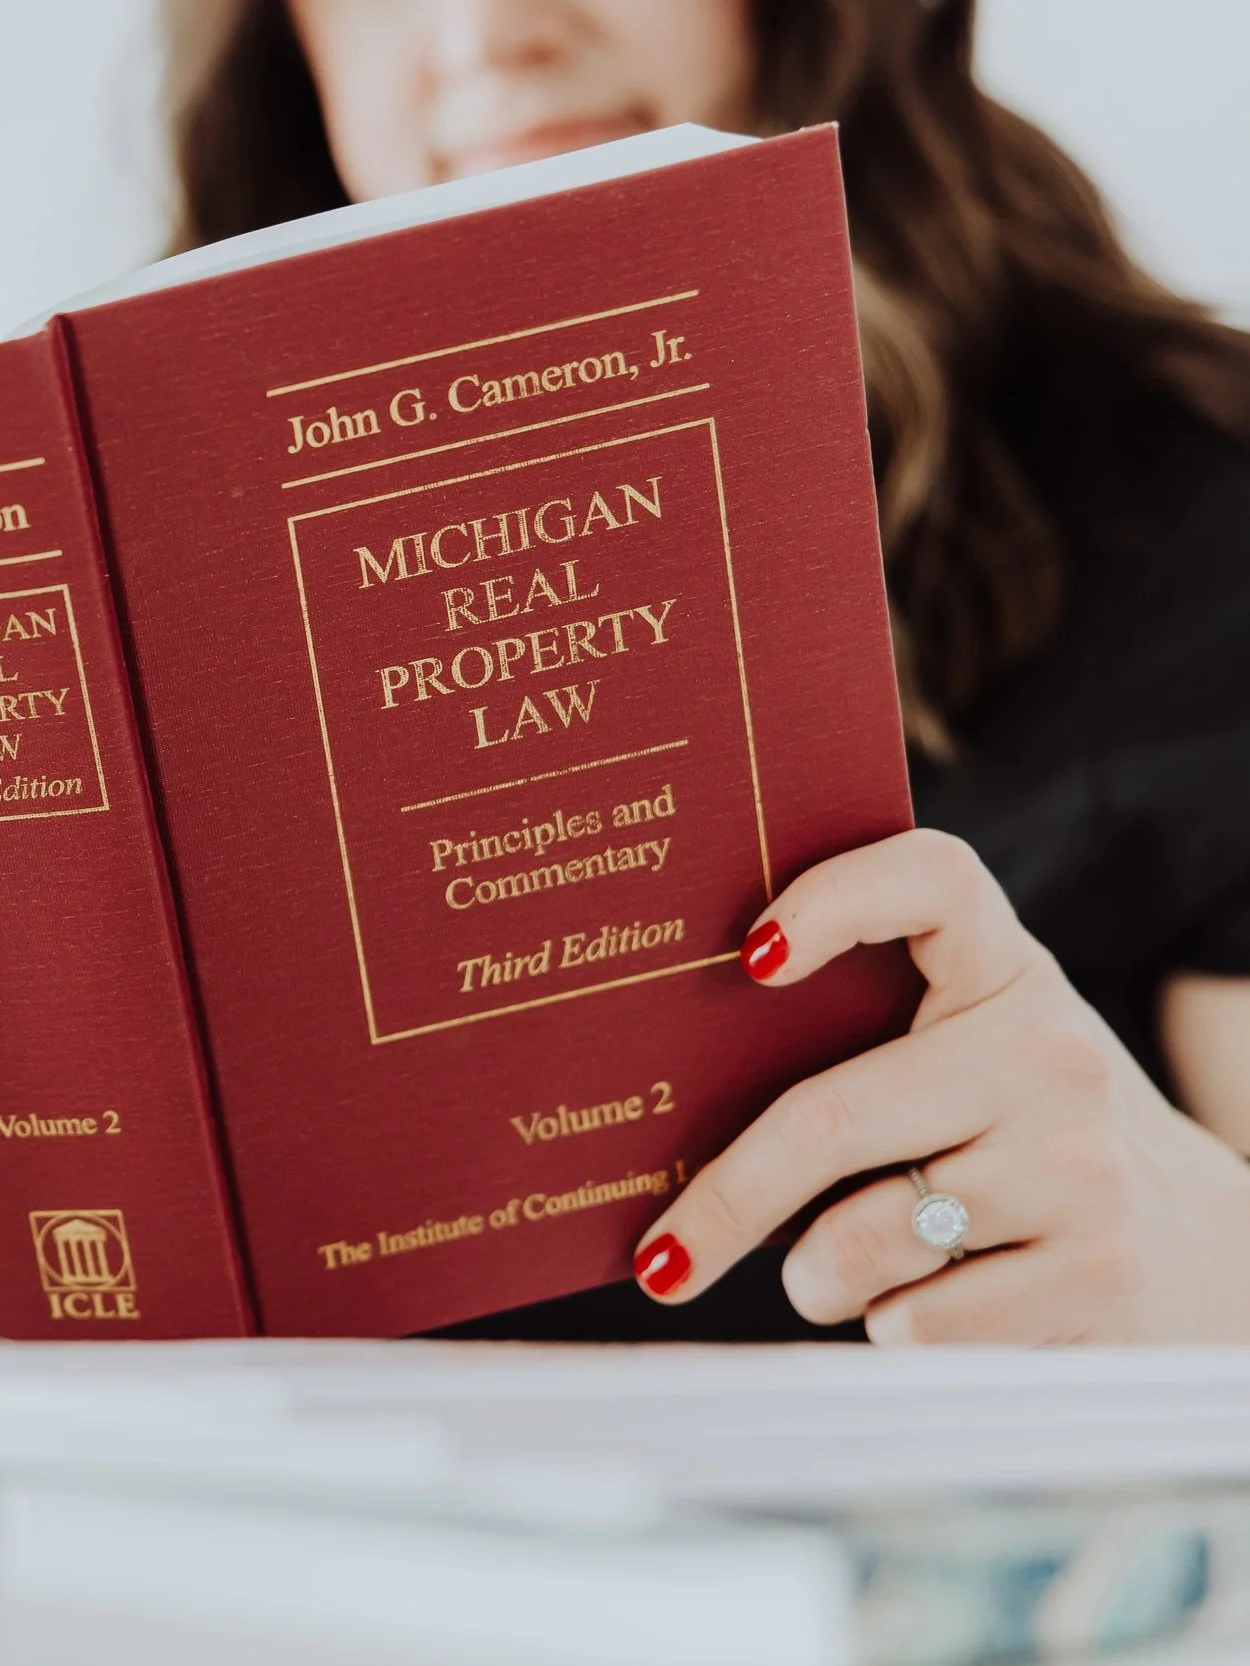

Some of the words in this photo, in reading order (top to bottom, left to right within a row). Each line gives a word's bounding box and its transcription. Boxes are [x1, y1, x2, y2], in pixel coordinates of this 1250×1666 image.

[287, 406, 381, 454] John
[390, 388, 437, 427] G.
[448, 349, 639, 412] Cameron,
[650, 330, 692, 368] Jr.
[353, 476, 662, 588] MICHIGAN
[441, 560, 599, 631] REAL
[375, 598, 677, 709] PROPERTY
[468, 679, 601, 749] LAW
[431, 808, 602, 871] Principles
[612, 784, 676, 829] and
[445, 836, 671, 910] Commentary
[457, 940, 552, 993] Third
[559, 918, 685, 970] Edition
[102, 1110, 122, 1134] 2
[511, 1093, 643, 1145] Volume
[651, 1081, 675, 1113] 2
[318, 1238, 371, 1269] The
[379, 1213, 482, 1256] Institute
[490, 1201, 518, 1229] of
[523, 1167, 668, 1222] Continuing
[49, 1292, 141, 1319] ICLE
